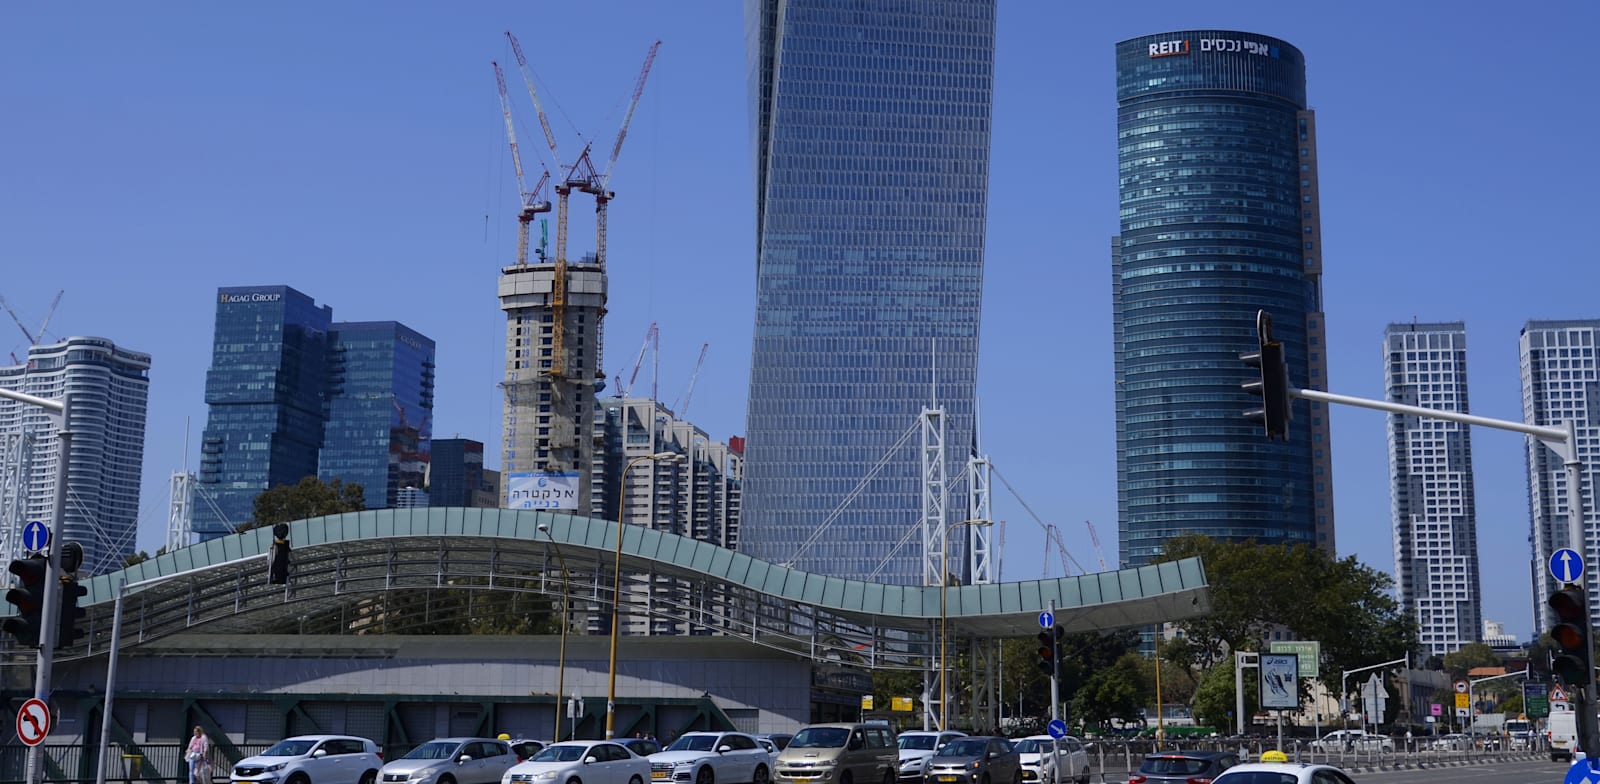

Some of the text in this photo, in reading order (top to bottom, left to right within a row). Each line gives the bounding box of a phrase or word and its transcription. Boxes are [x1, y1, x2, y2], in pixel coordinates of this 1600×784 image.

[1200, 38, 1241, 52] נכסים
[252, 293, 281, 302] GROUP
[512, 488, 574, 500] אלקטרה
[524, 500, 560, 508] בנייה
